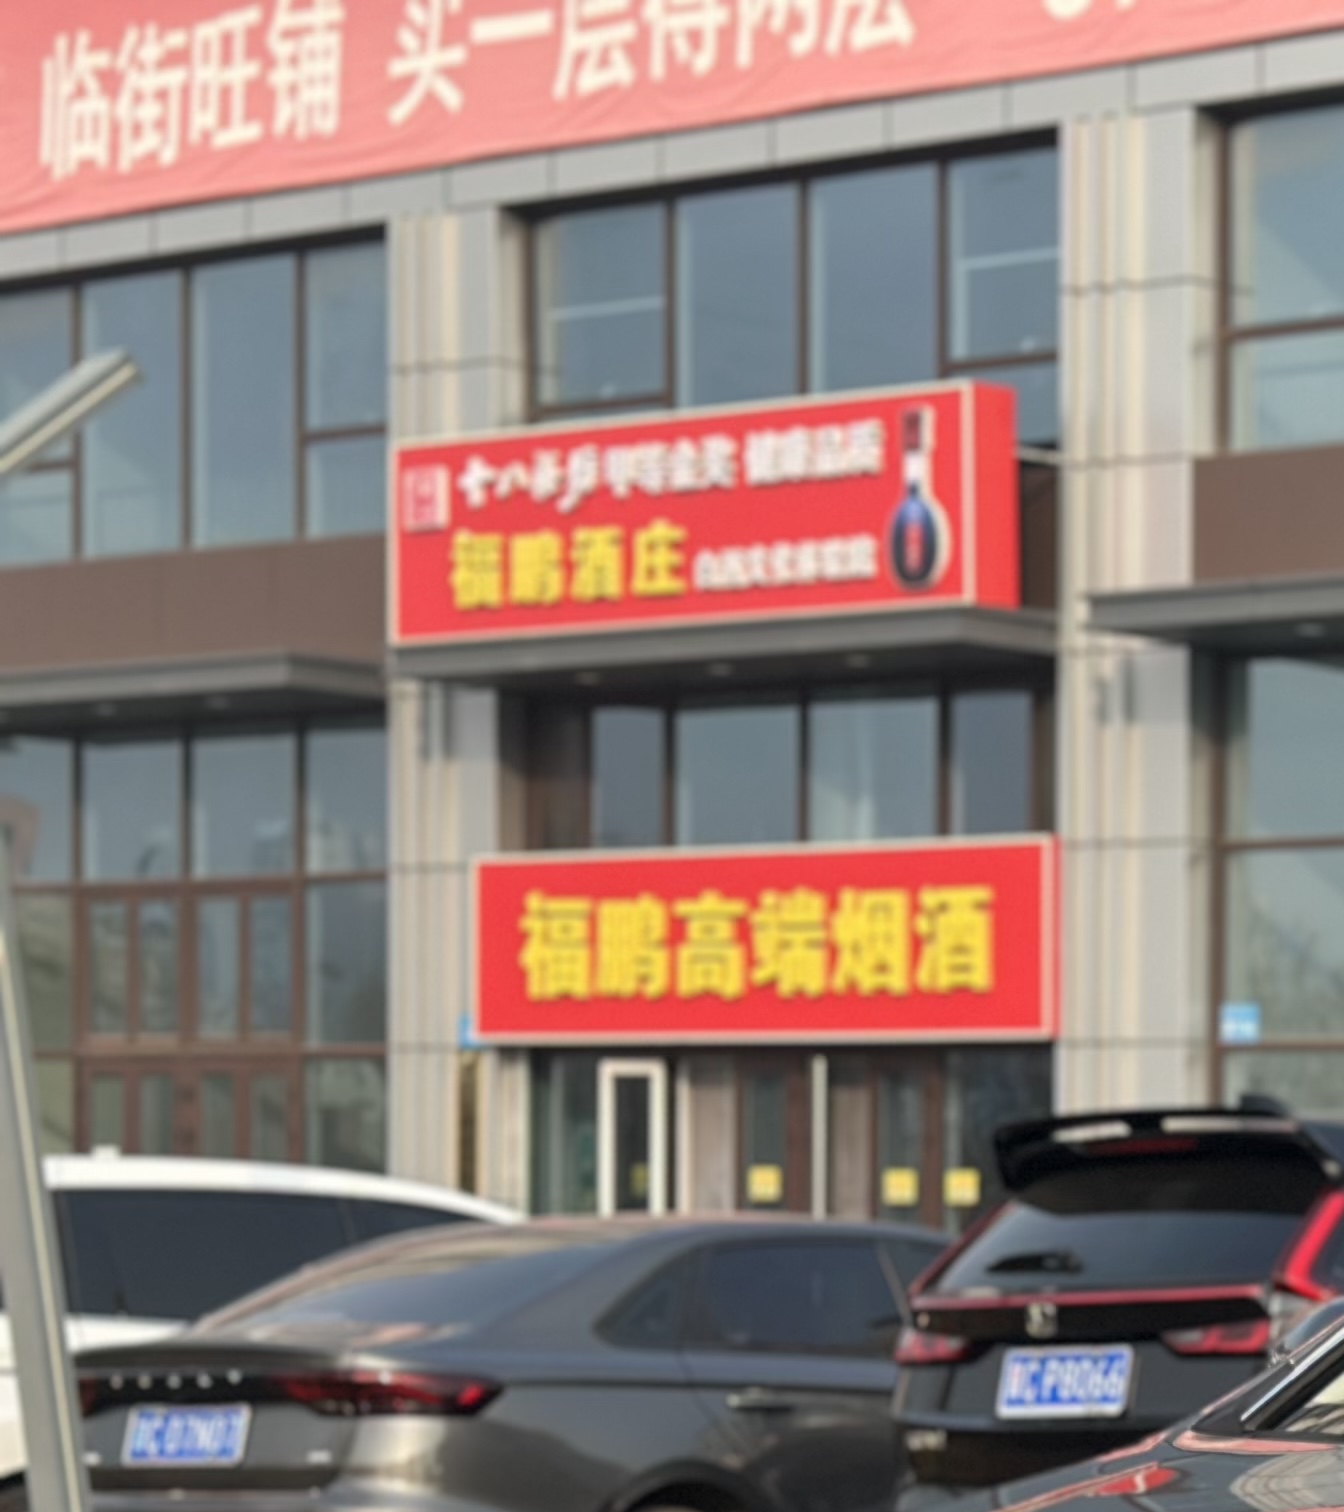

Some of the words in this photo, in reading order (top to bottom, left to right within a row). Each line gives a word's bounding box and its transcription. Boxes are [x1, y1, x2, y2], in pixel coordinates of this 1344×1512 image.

[39, 0, 346, 181] 临街旺铺
[450, 518, 687, 610] 福鹏酒庄
[519, 885, 994, 1000] 福鹏高端烟酒
